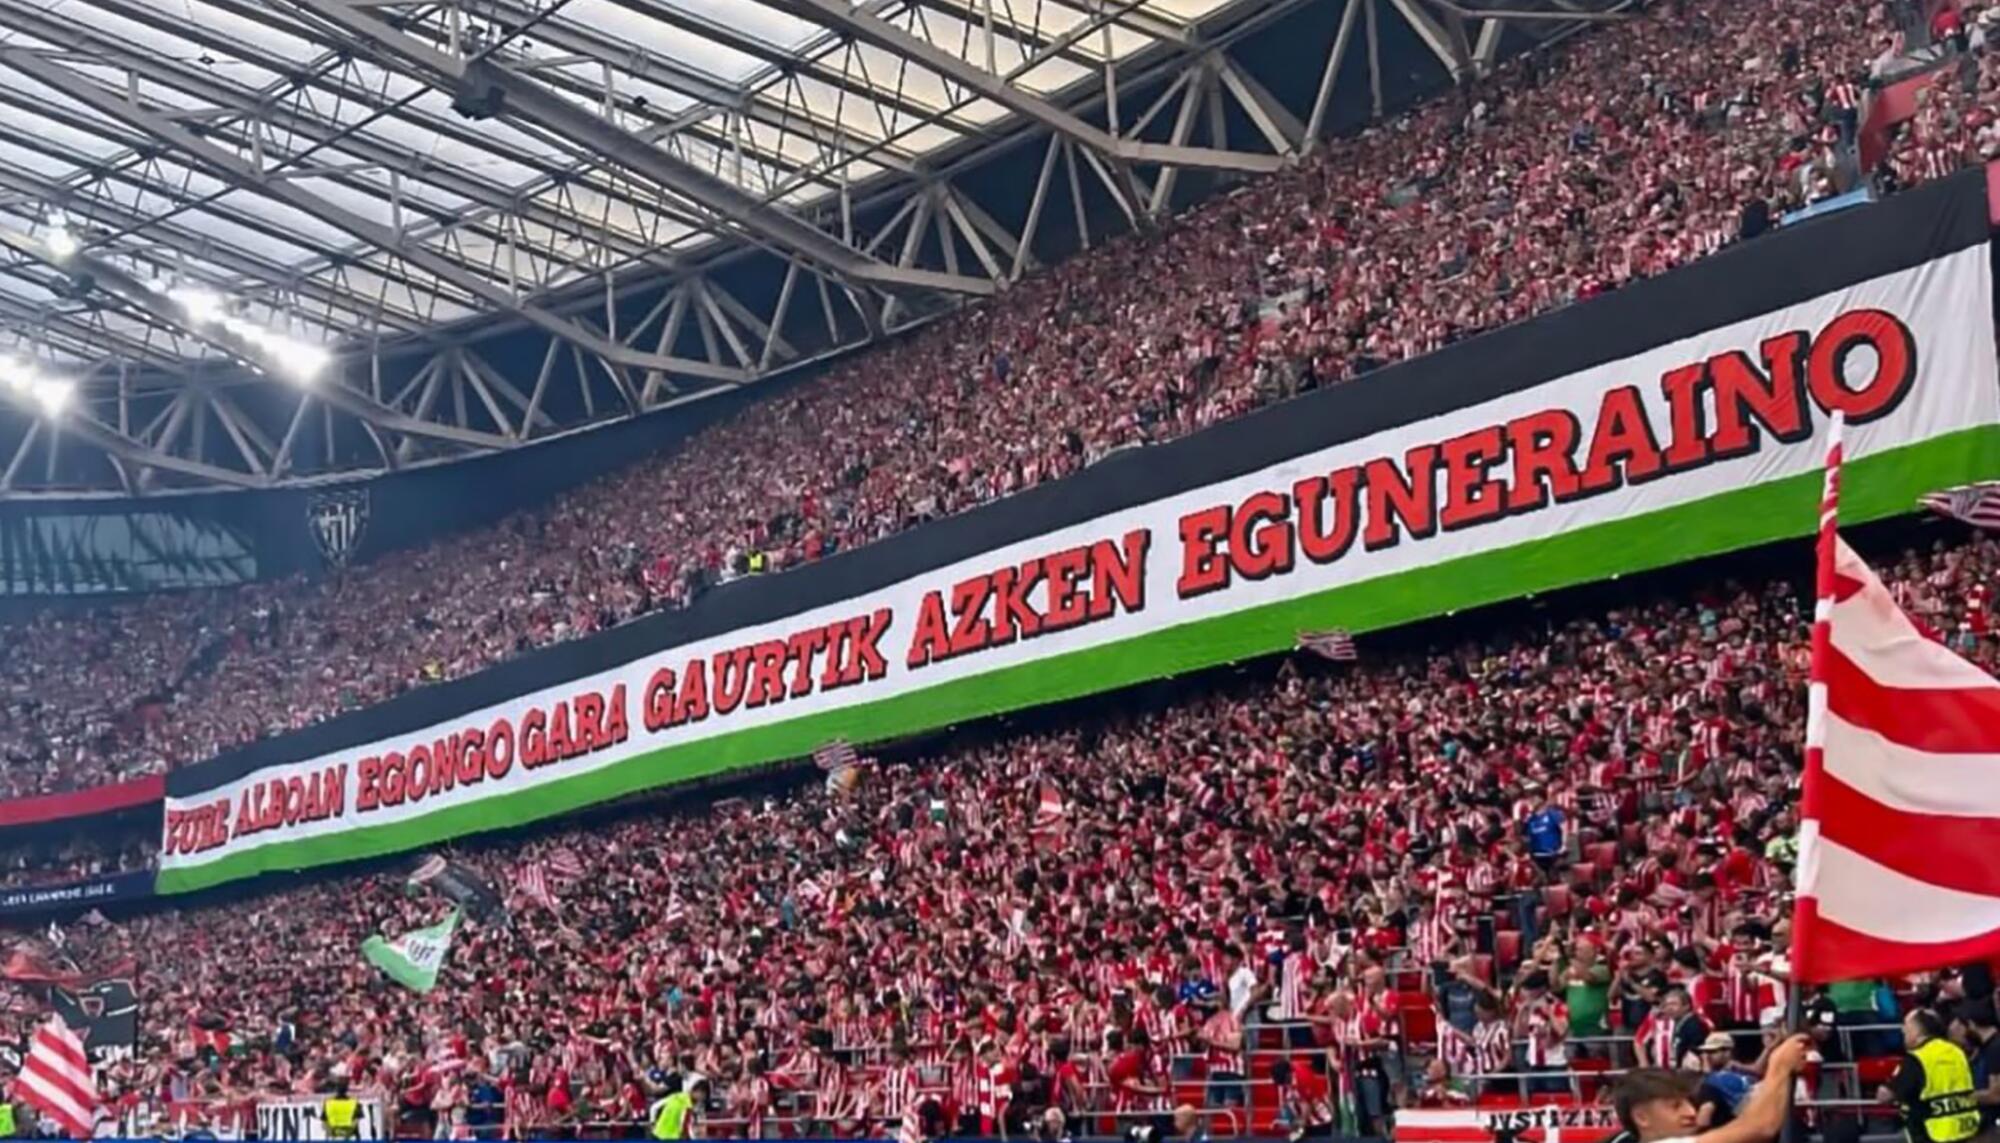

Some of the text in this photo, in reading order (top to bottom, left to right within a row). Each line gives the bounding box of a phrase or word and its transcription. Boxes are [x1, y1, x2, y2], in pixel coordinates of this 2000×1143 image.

[232, 763, 348, 840] ALBOAN
[356, 719, 515, 813] EGONGO
[518, 683, 629, 770] GARA
[643, 607, 893, 733] GAURTIK
[906, 528, 1152, 671] AZKEN
[1177, 308, 1918, 600] EGUNERAINO
